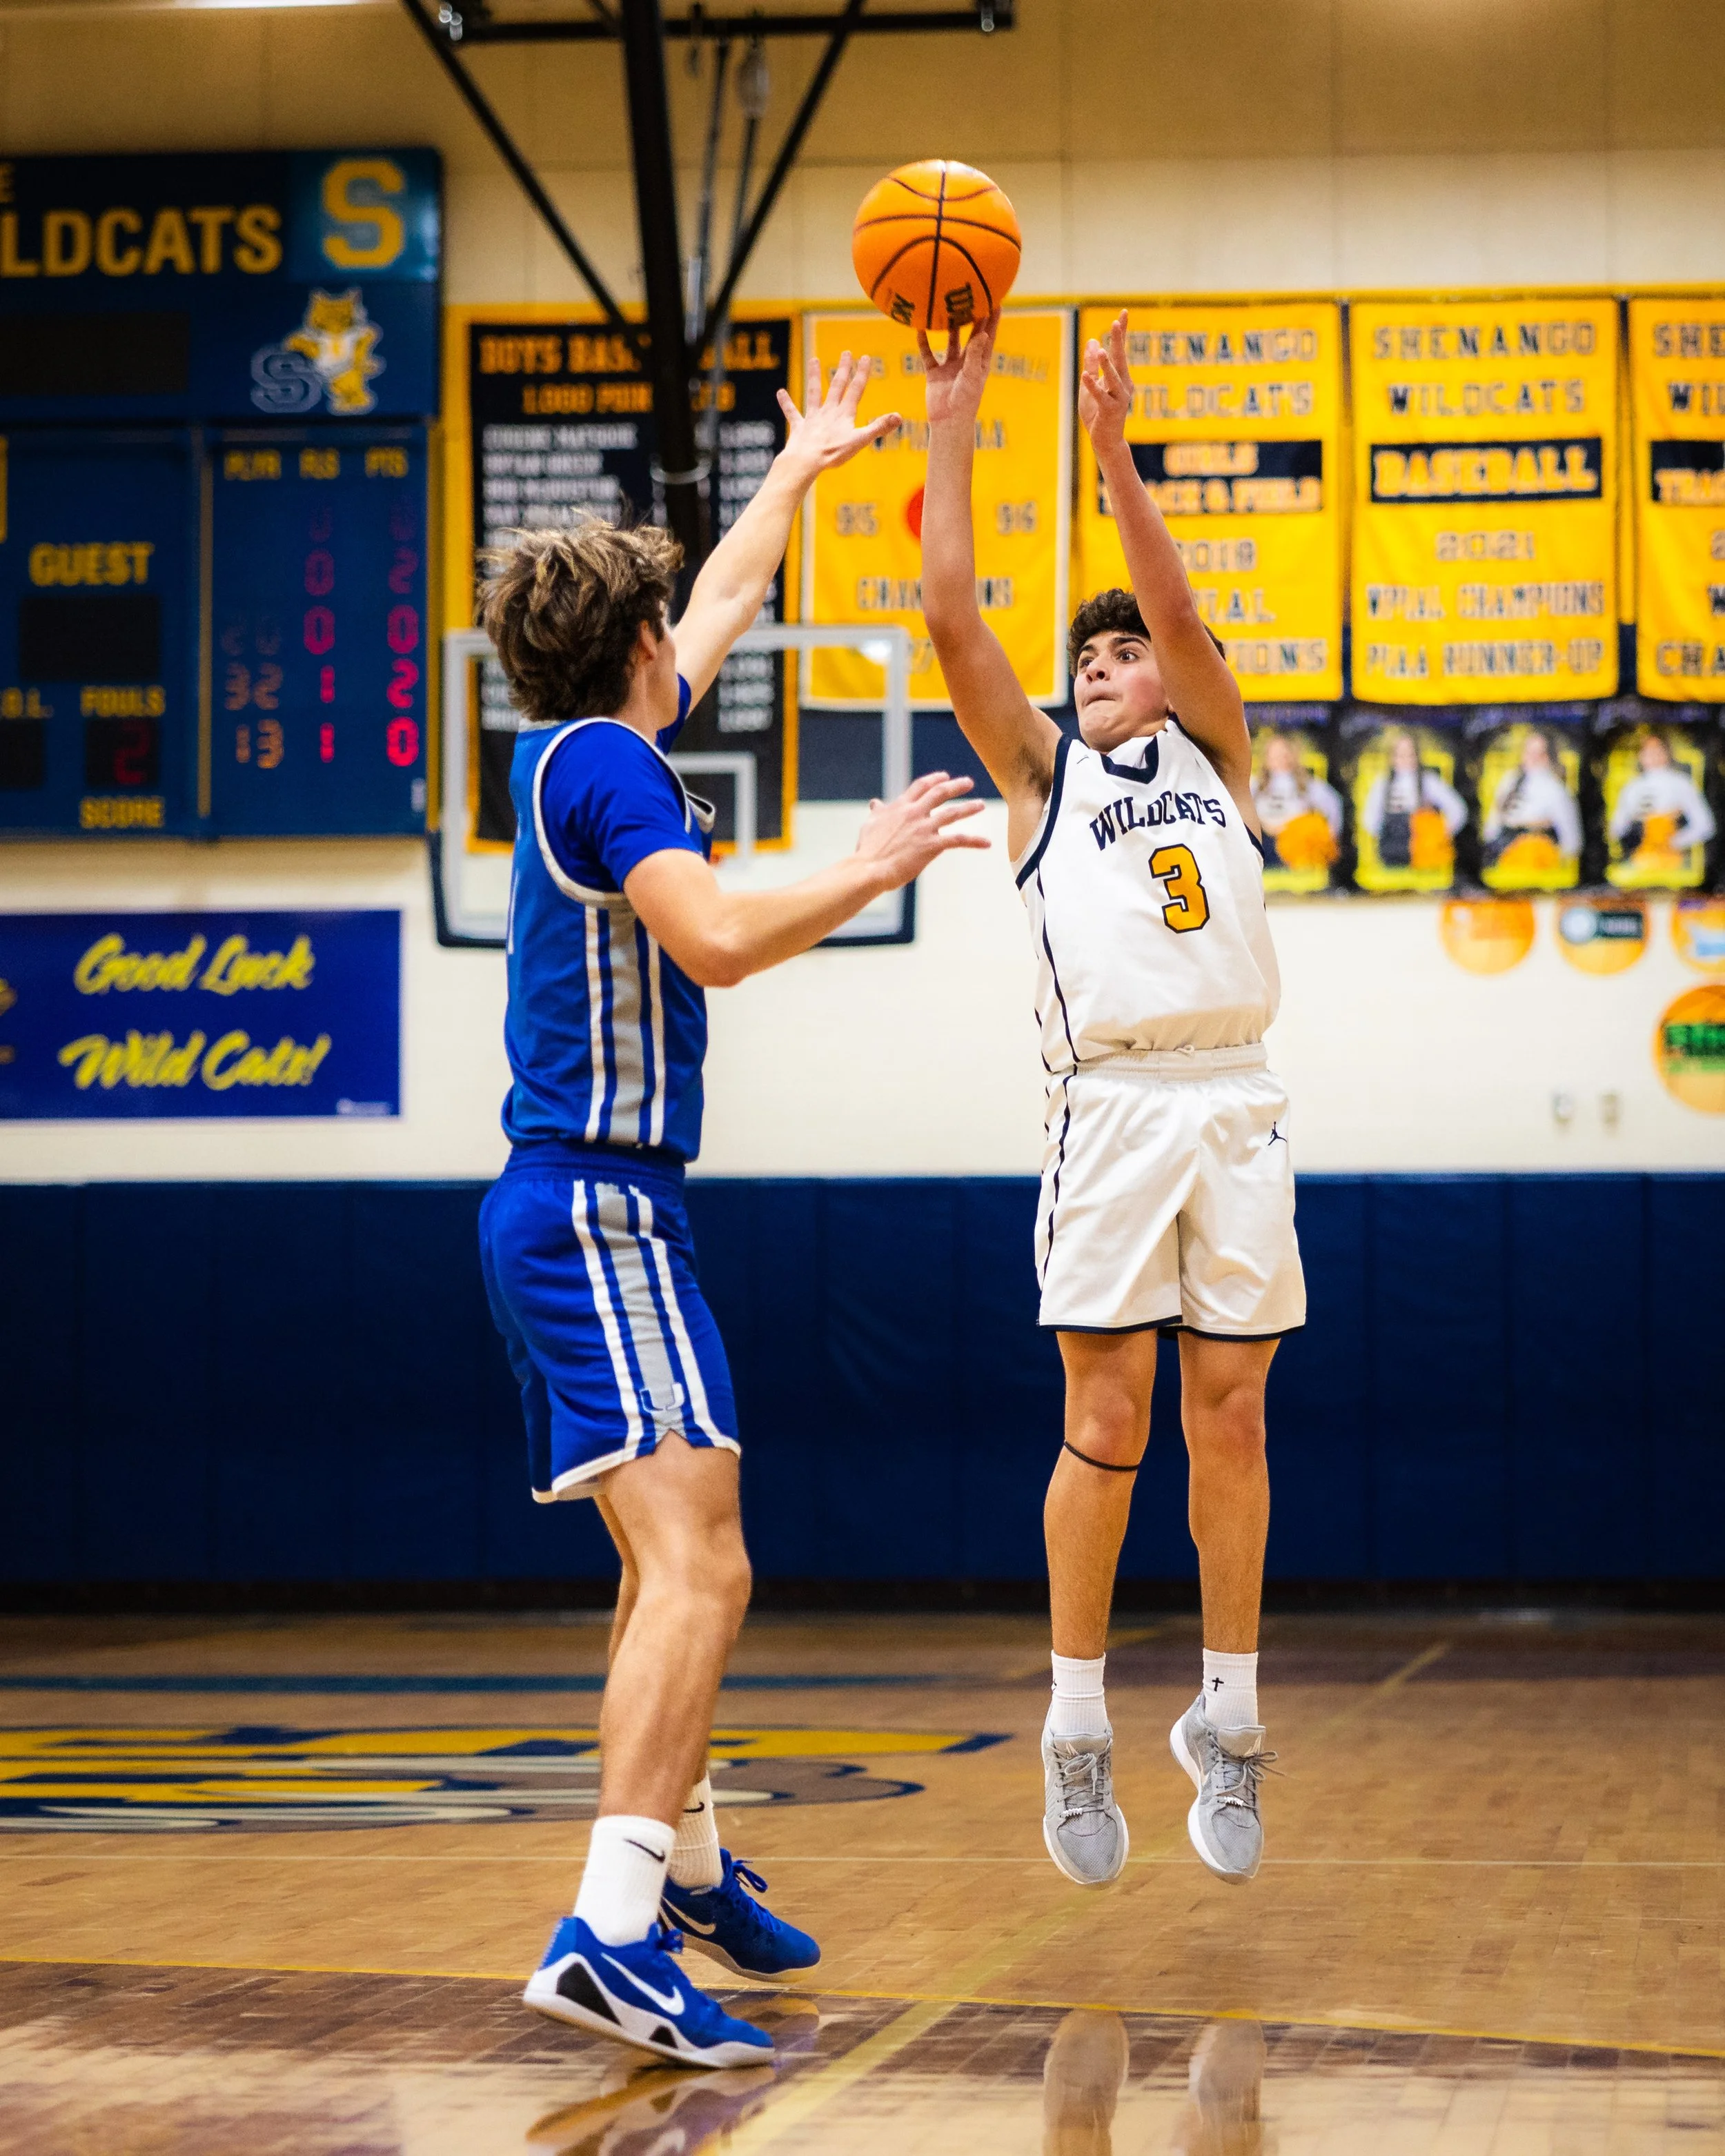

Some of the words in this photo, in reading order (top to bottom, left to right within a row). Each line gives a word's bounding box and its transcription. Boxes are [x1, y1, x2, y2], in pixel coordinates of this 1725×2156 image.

[322, 159, 404, 268] S
[1374, 323, 1595, 361] SHENANGO
[1126, 382, 1313, 421] ILDCATS
[1388, 379, 1586, 417] WILDCATS
[1372, 446, 1598, 497] BASEBALL
[28, 542, 155, 586] GUEST
[303, 604, 335, 655] 0
[387, 604, 420, 655] 0
[386, 658, 420, 709] 2
[386, 716, 420, 767] 0
[1089, 791, 1226, 851] WILDCATS
[1148, 842, 1210, 934] 3
[74, 933, 207, 995] Good
[199, 933, 316, 996] Luck
[57, 1029, 206, 1090] Wild
